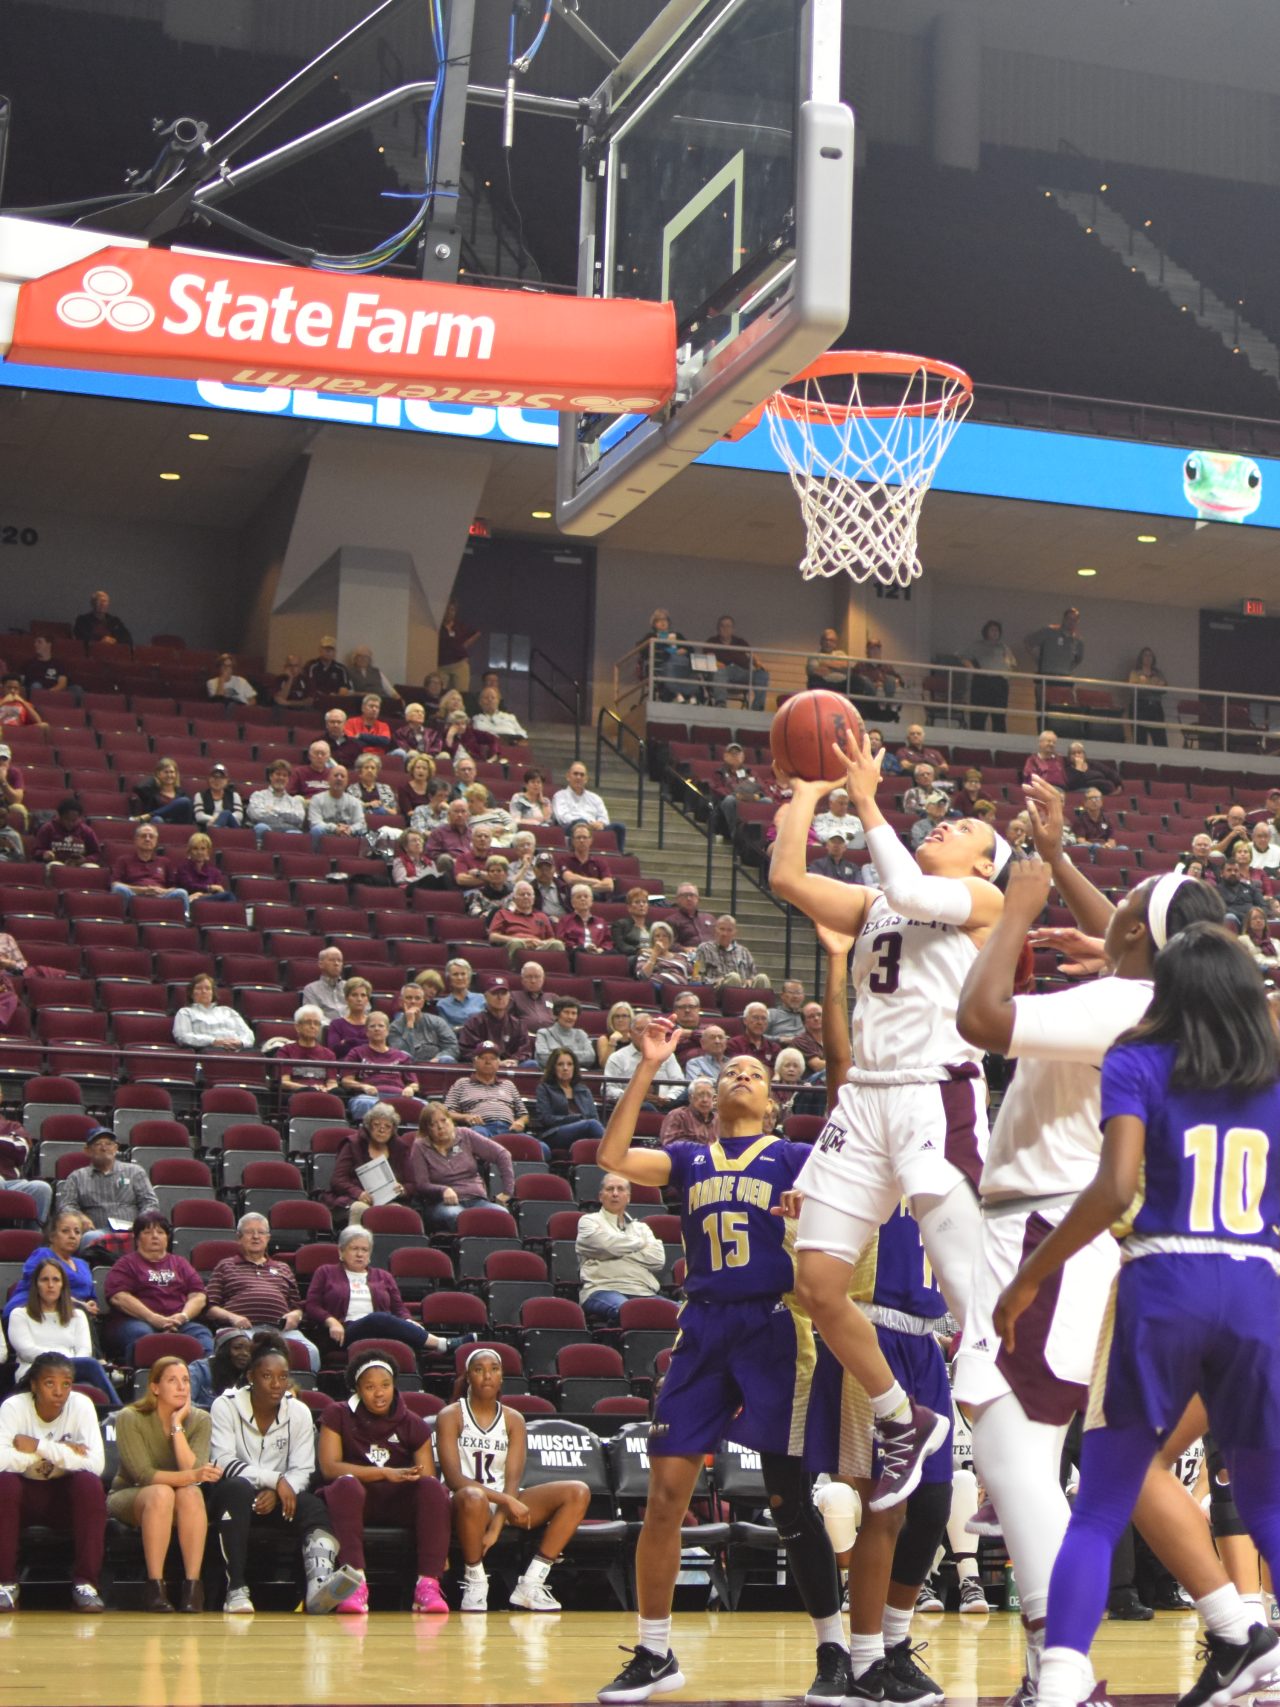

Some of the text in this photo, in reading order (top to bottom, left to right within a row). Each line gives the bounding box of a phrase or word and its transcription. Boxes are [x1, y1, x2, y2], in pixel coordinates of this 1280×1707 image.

[861, 915, 902, 936] EXAS
[869, 931, 903, 994] 3
[689, 1175, 773, 1215] PRAIRIE VIEW
[1183, 1124, 1270, 1235] 10
[703, 1212, 750, 1271] 15
[527, 1434, 593, 1451] MUSCLE
